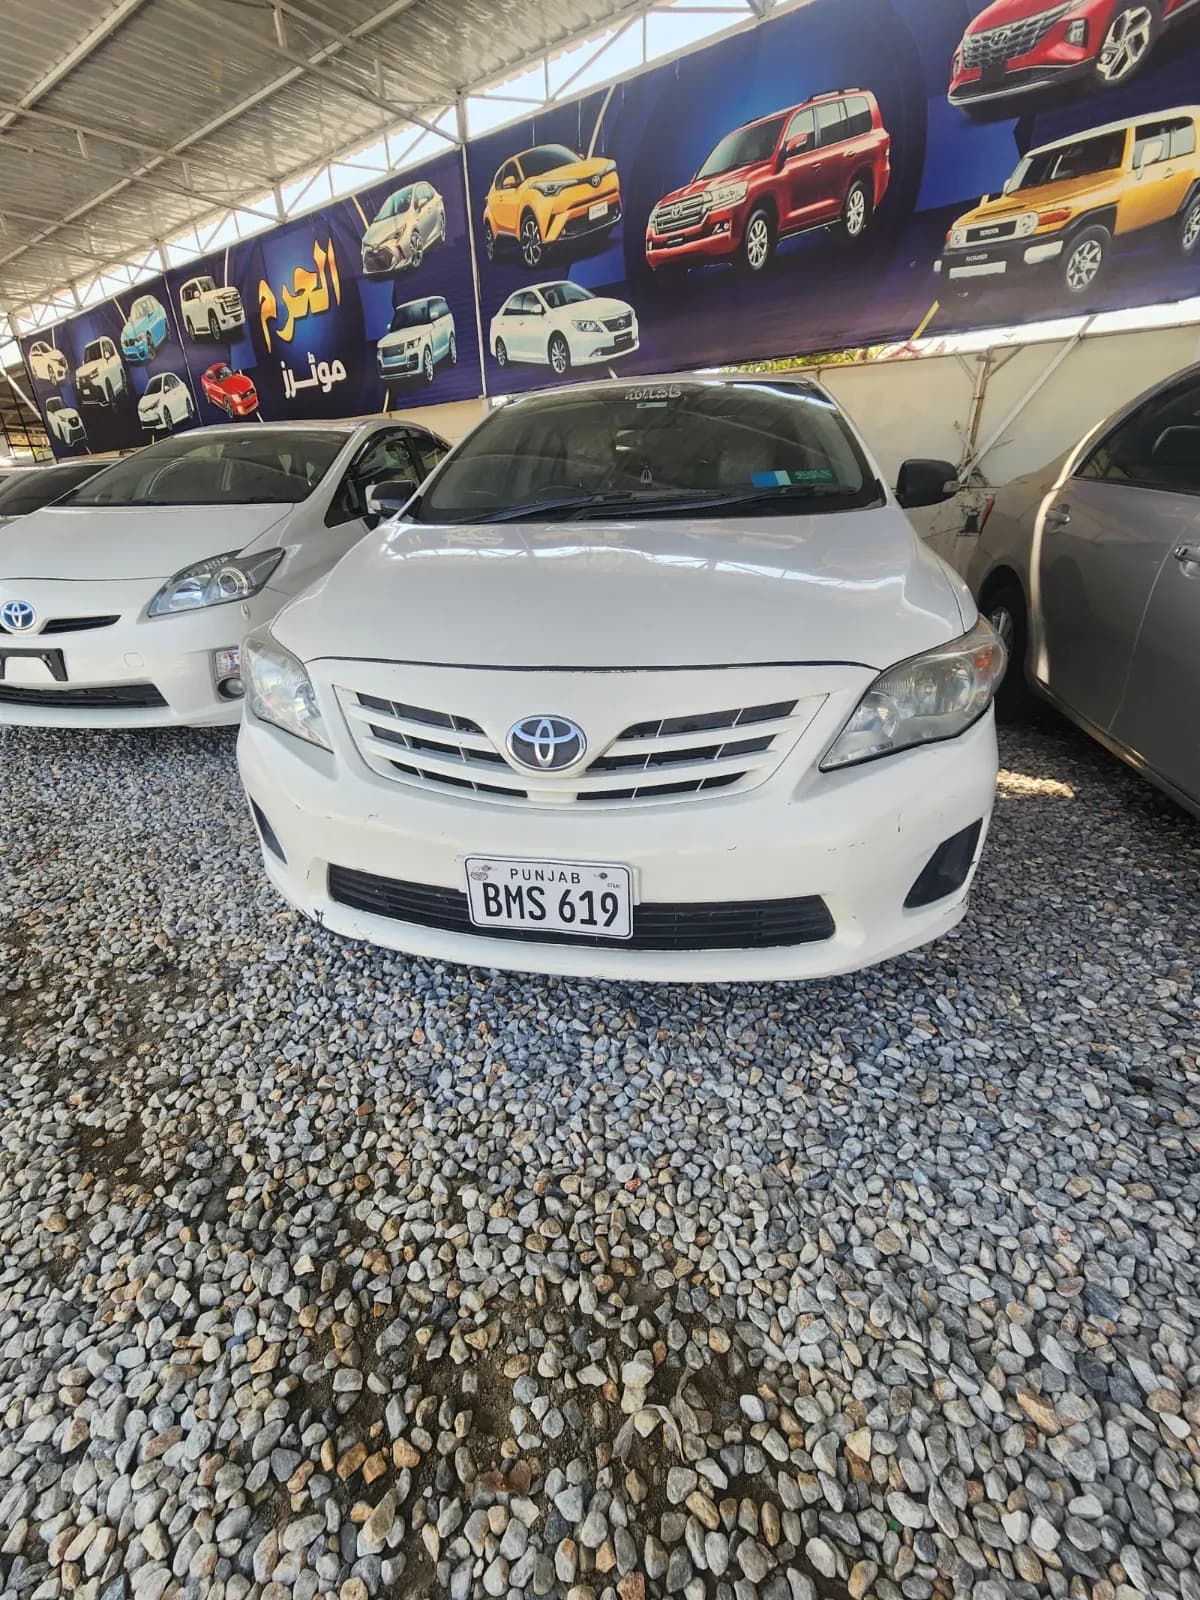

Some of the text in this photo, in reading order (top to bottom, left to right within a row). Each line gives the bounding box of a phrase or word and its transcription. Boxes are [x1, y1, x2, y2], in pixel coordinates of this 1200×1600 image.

[258, 237, 341, 354] الحرم
[510, 868, 581, 884] PUNJAB
[482, 882, 619, 927] BMS 619
